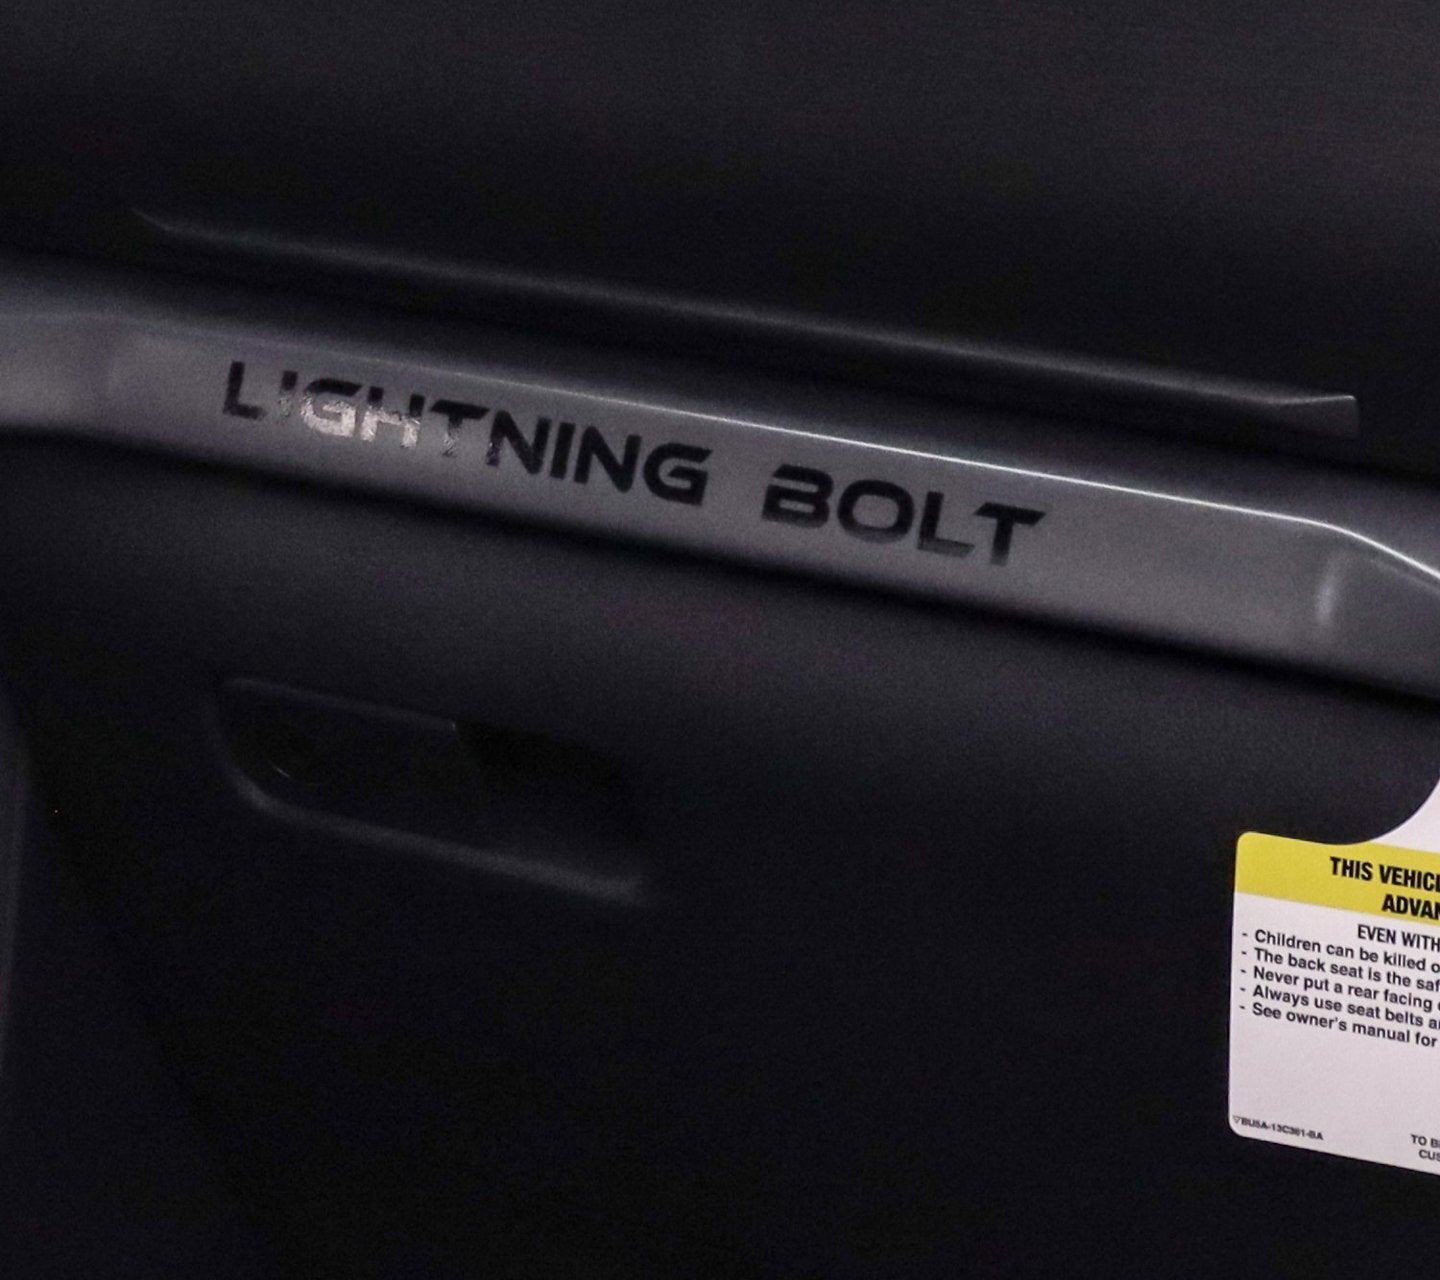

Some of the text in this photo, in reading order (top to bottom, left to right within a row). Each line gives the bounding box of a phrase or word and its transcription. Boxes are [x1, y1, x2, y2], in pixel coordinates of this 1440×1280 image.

[223, 360, 1048, 568] LIGHTNING BOLT
[1329, 856, 1373, 881] THIS
[1254, 929, 1321, 953] Children
[1326, 944, 1354, 959] can
[1359, 947, 1379, 963] be
[1383, 951, 1426, 972] killed
[1357, 924, 1397, 945] EVEN
[1401, 931, 1440, 953] WITH
[1253, 947, 1284, 965] The
[1288, 953, 1325, 973] back
[1330, 962, 1364, 979] seat
[1368, 966, 1382, 982] is
[1386, 970, 1411, 987] the
[1252, 984, 1310, 1007] Always
[1314, 997, 1342, 1012] use
[1347, 1002, 1381, 1019] seat
[1385, 1007, 1424, 1027] belts
[1253, 966, 1300, 986] Never
[1303, 976, 1329, 992] put
[1334, 982, 1343, 994] a
[1347, 984, 1378, 1000] rear
[1383, 988, 1433, 1013] facing
[1252, 1002, 1282, 1020] See
[1285, 1009, 1347, 1032] owner's
[1352, 1021, 1411, 1043] manual
[1415, 1032, 1438, 1048] for
[1410, 1134, 1427, 1147] TO
